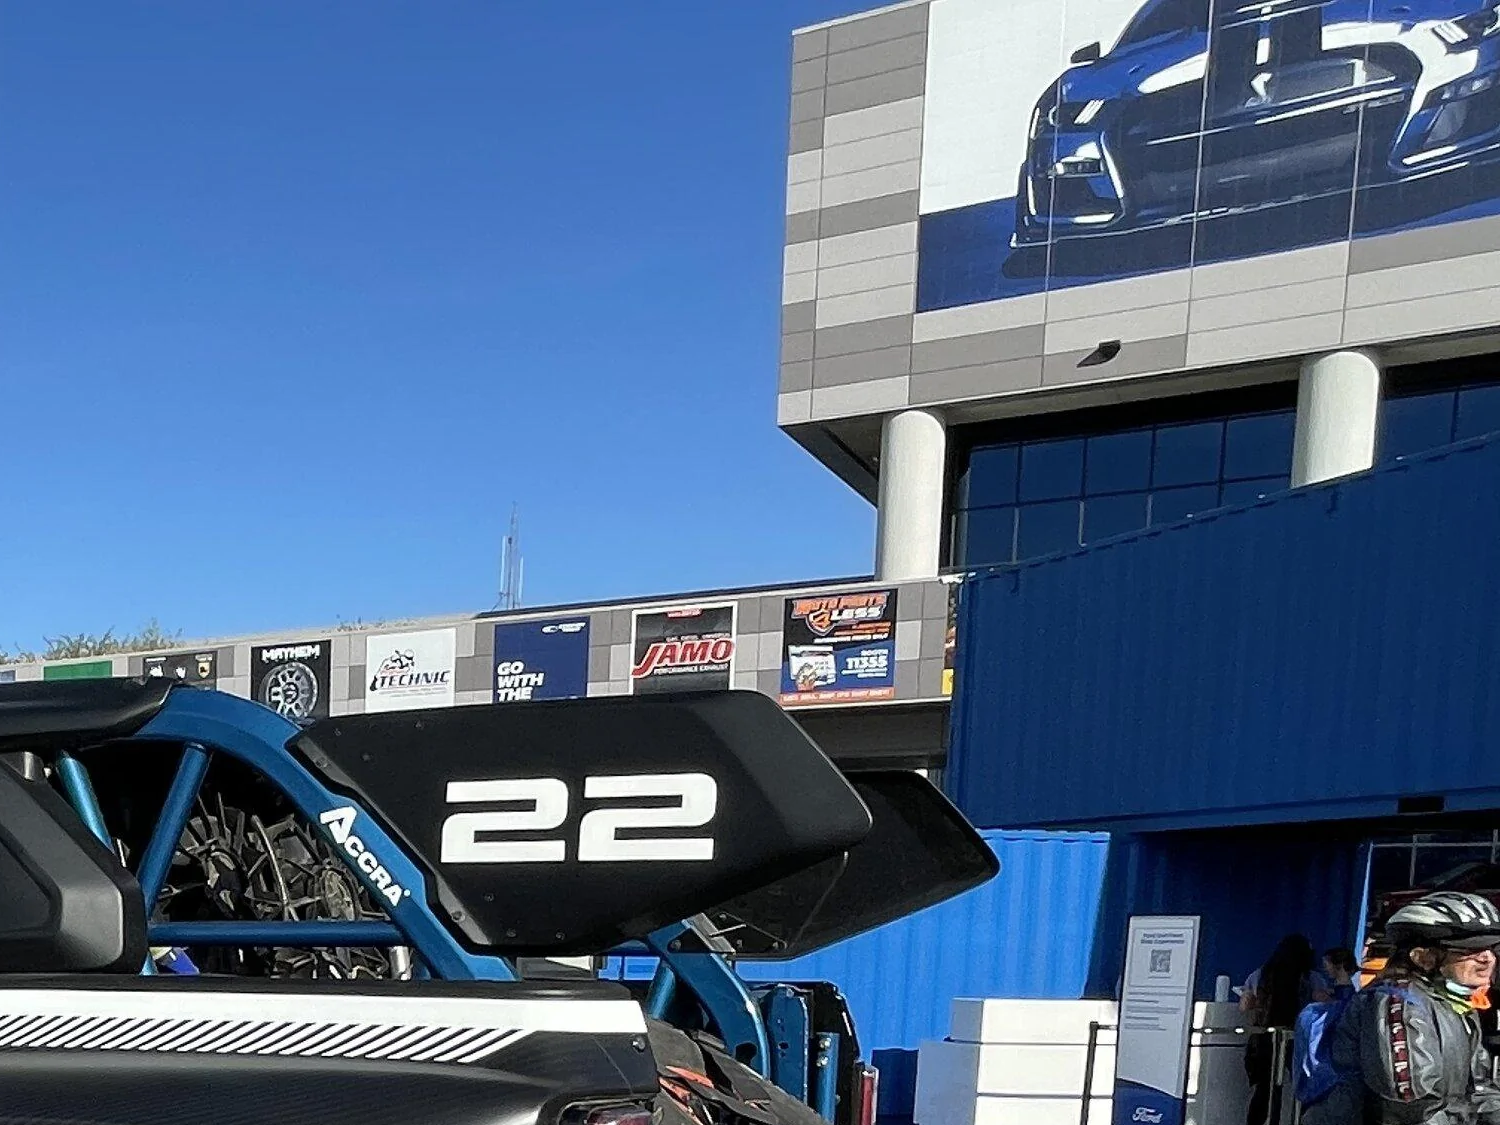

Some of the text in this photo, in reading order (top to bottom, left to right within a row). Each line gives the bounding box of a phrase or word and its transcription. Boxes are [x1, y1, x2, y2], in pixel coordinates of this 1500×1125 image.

[830, 606, 881, 620] LESS
[261, 644, 320, 663] MAYHEM
[630, 638, 734, 678] JAMO
[497, 661, 524, 676] GO
[497, 672, 545, 688] WITH
[497, 687, 533, 702] THE
[440, 772, 718, 863] 22
[319, 806, 403, 906] ACCRA
[1132, 1107, 1163, 1124] Ford
